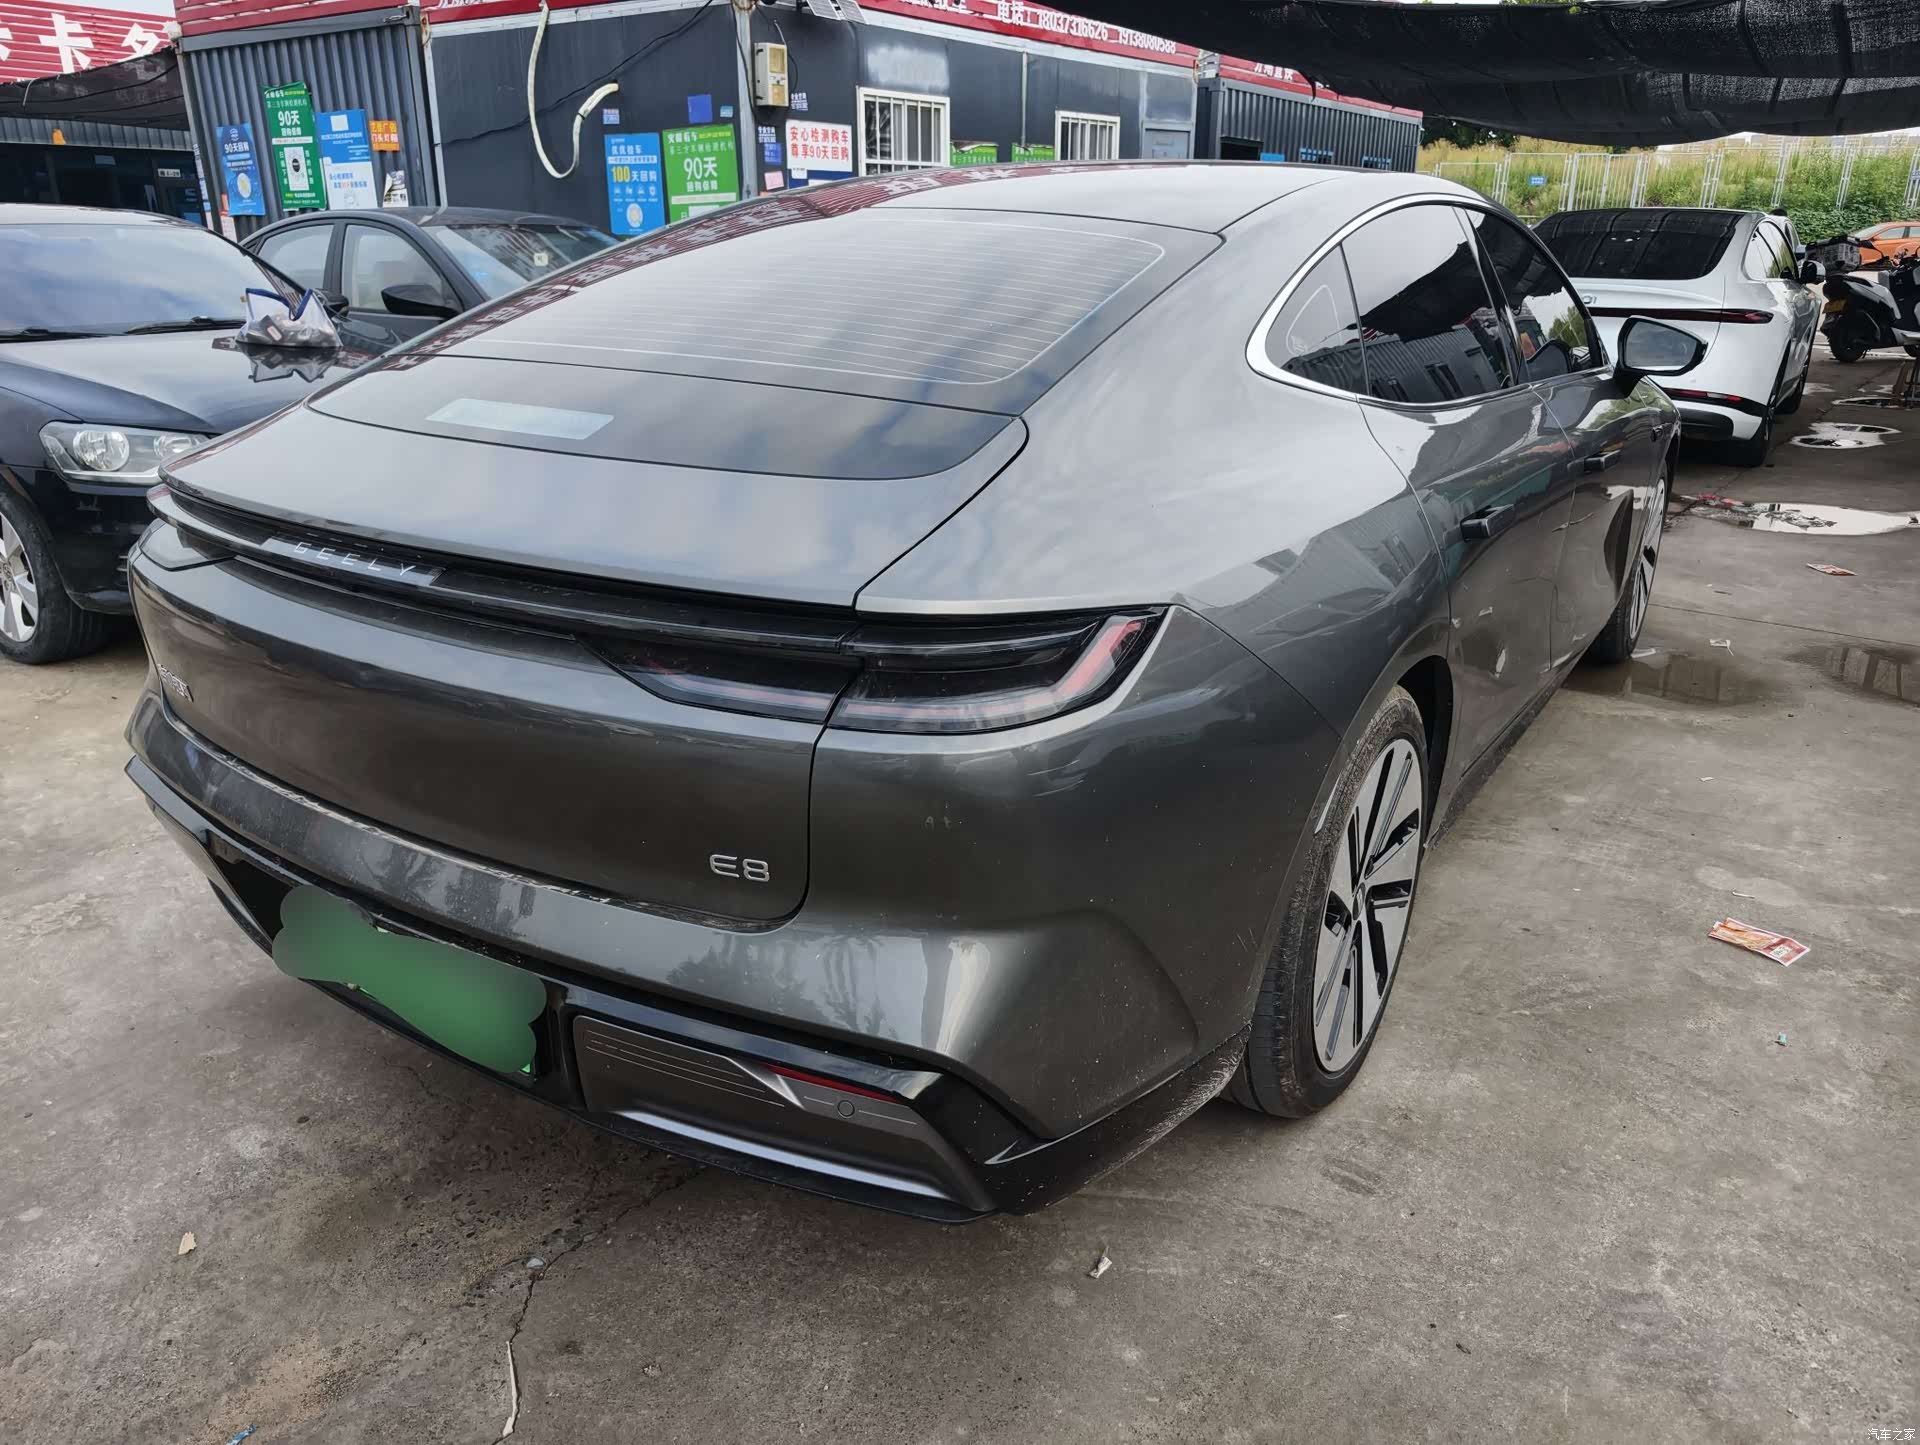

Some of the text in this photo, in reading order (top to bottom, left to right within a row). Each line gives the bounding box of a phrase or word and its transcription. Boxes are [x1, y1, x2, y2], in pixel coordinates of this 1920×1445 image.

[278, 110, 300, 127] 90天
[790, 126, 849, 144] 安心检测购车
[790, 143, 849, 161] 尊享90天回购
[611, 166, 657, 183] 100天回购
[683, 156, 718, 181] 90天
[293, 541, 417, 577] GEELY
[709, 853, 770, 882] E8
